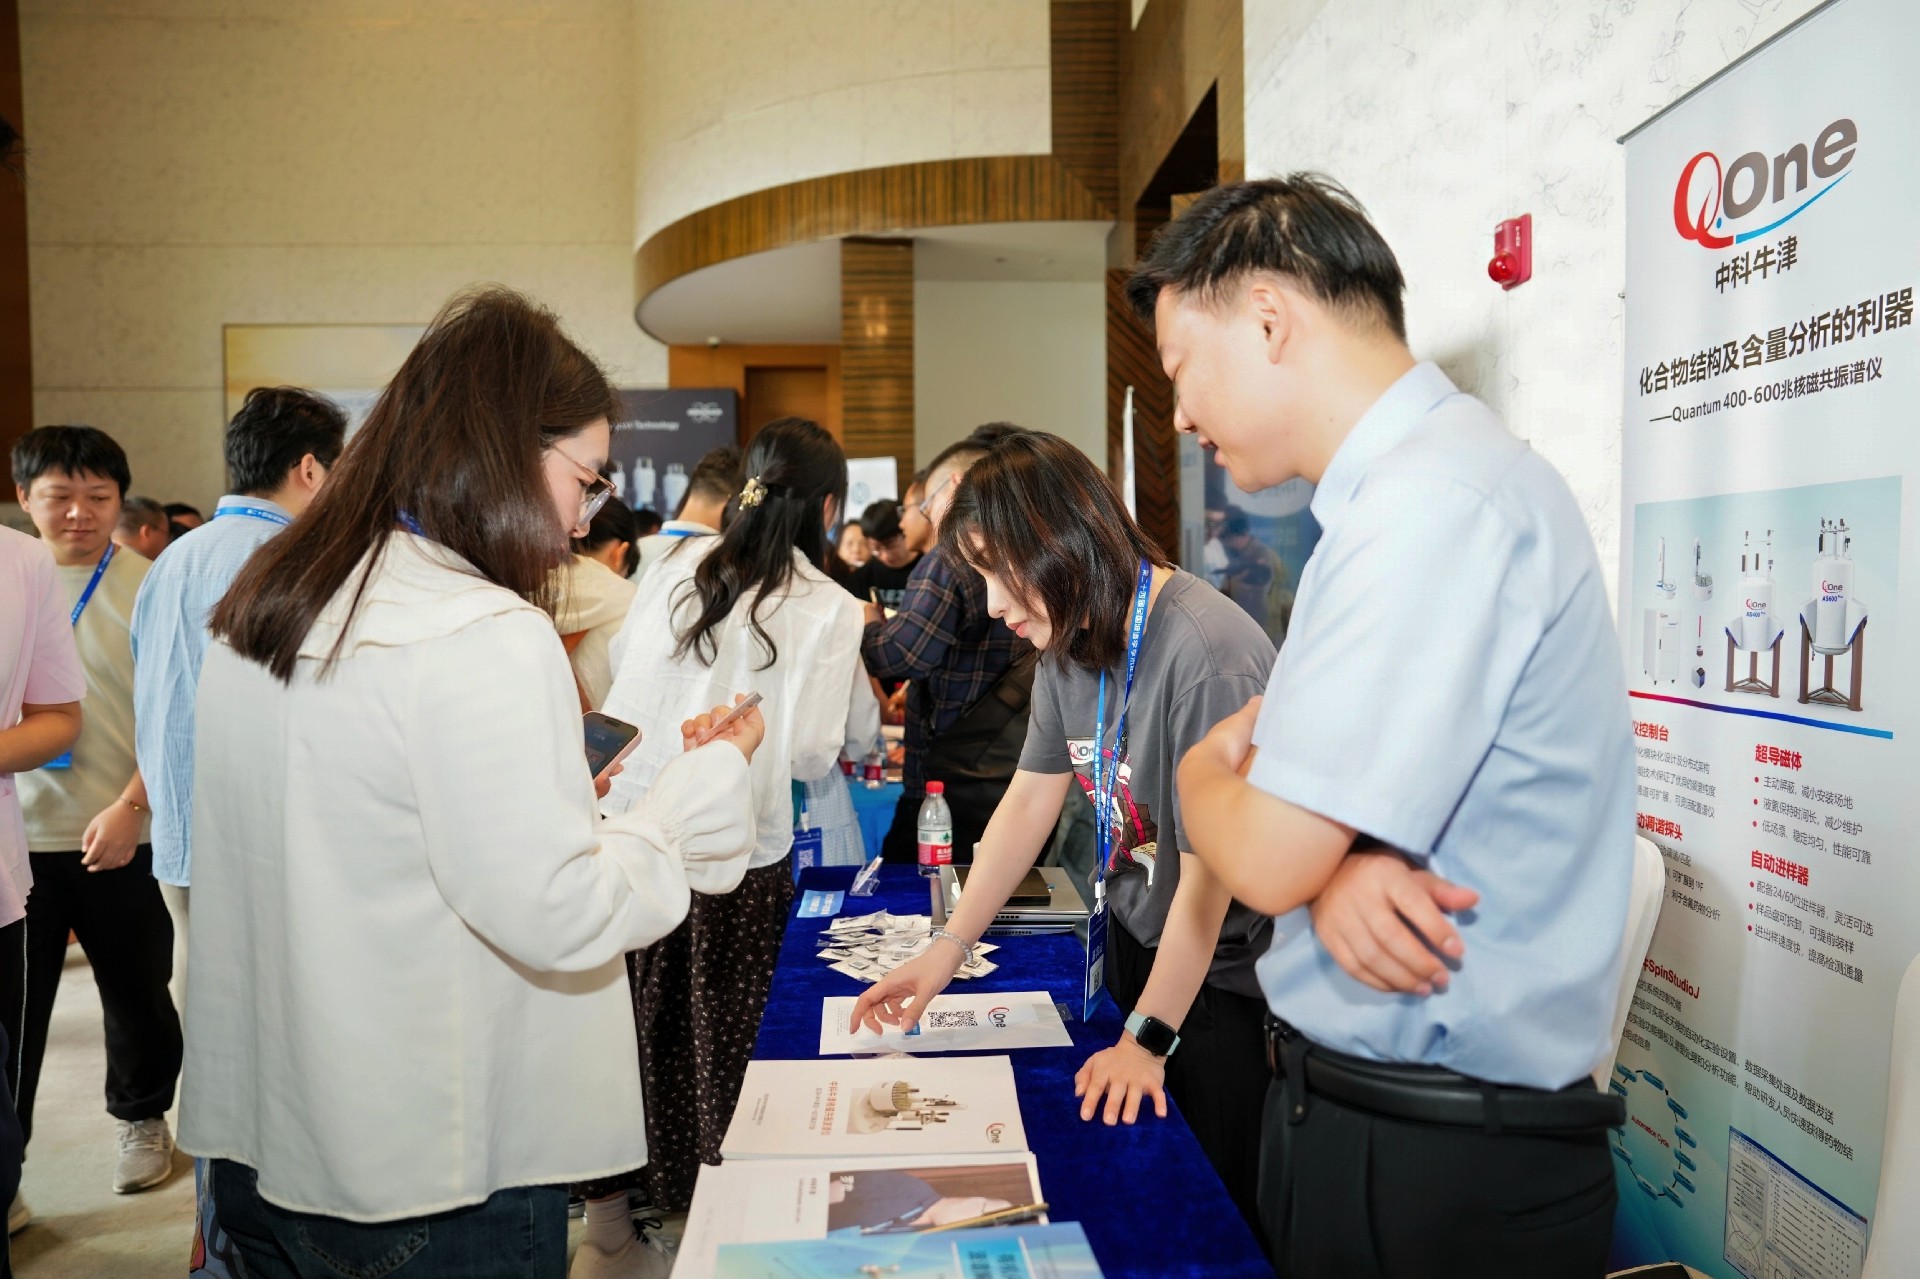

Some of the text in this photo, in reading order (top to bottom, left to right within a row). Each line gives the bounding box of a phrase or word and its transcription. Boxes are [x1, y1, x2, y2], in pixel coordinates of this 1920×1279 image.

[1715, 235, 1798, 294] 中科牛津
[1639, 286, 1914, 397] 化合物结构及含量分析的利器
[1723, 356, 1883, 409] 400-600兆核磁共振谱仪
[1068, 742, 1095, 761] QOn
[1755, 743, 1803, 772] 超导磁体
[1750, 849, 1809, 887] 自动进样器
